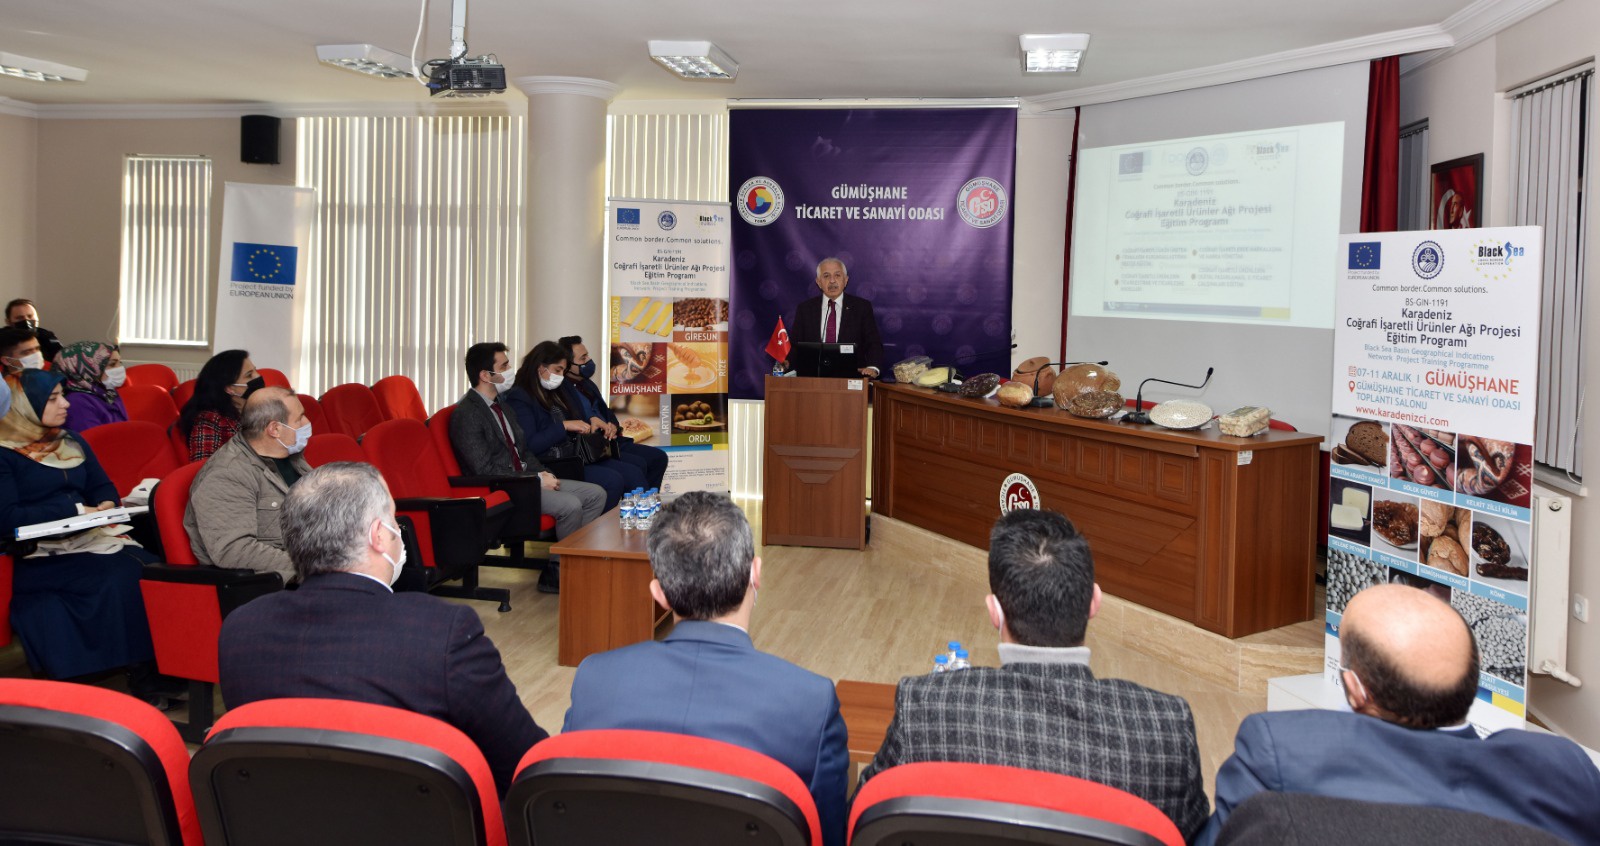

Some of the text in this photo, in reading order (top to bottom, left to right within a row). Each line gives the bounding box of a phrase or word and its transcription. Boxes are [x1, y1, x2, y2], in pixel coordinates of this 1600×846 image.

[831, 184, 908, 202] GÜMÜŞHANE
[1174, 197, 1217, 207] Karadeniz
[795, 204, 944, 220] TİCARET VE SANAYİ ODASI
[1238, 204, 1272, 216] Projesi
[1160, 217, 1229, 229] Eğitim Programı
[1478, 245, 1503, 257] Black
[614, 262, 638, 270] Coğrafi
[639, 262, 662, 271] İşaretli
[691, 264, 701, 273] Ağı
[702, 265, 725, 273] Projesi
[644, 271, 696, 280] Eğitim Programı
[230, 282, 256, 290] Project
[1372, 284, 1399, 292] Common
[1454, 286, 1488, 294] solutions.
[229, 290, 270, 298] EUROPEAN
[1401, 308, 1452, 321] Karadeniz
[1346, 317, 1521, 340] Coğrafi İşaretli Ürünler Ağı Projesi
[685, 331, 717, 341] GİRESUN
[1386, 333, 1467, 348] Eğitim Programı
[1364, 343, 1380, 351] Black
[1411, 347, 1454, 358] Geographical
[1455, 350, 1495, 361] Indications
[1367, 352, 1489, 371] Network Project Training Programme
[1357, 367, 1380, 378] 07-11
[1382, 370, 1412, 382] ARALIK
[1425, 369, 1520, 394] GÜMÜŞHANE
[612, 383, 663, 394] GÜMÜŞHANE
[1356, 381, 1521, 410] GÜMÜŞHANE TİCARET VE SANAYİ ODASI
[1356, 392, 1428, 410] TOPLANTI SALONU
[1355, 405, 1449, 427] www.karadenizci.com
[688, 435, 711, 443] ORDU
